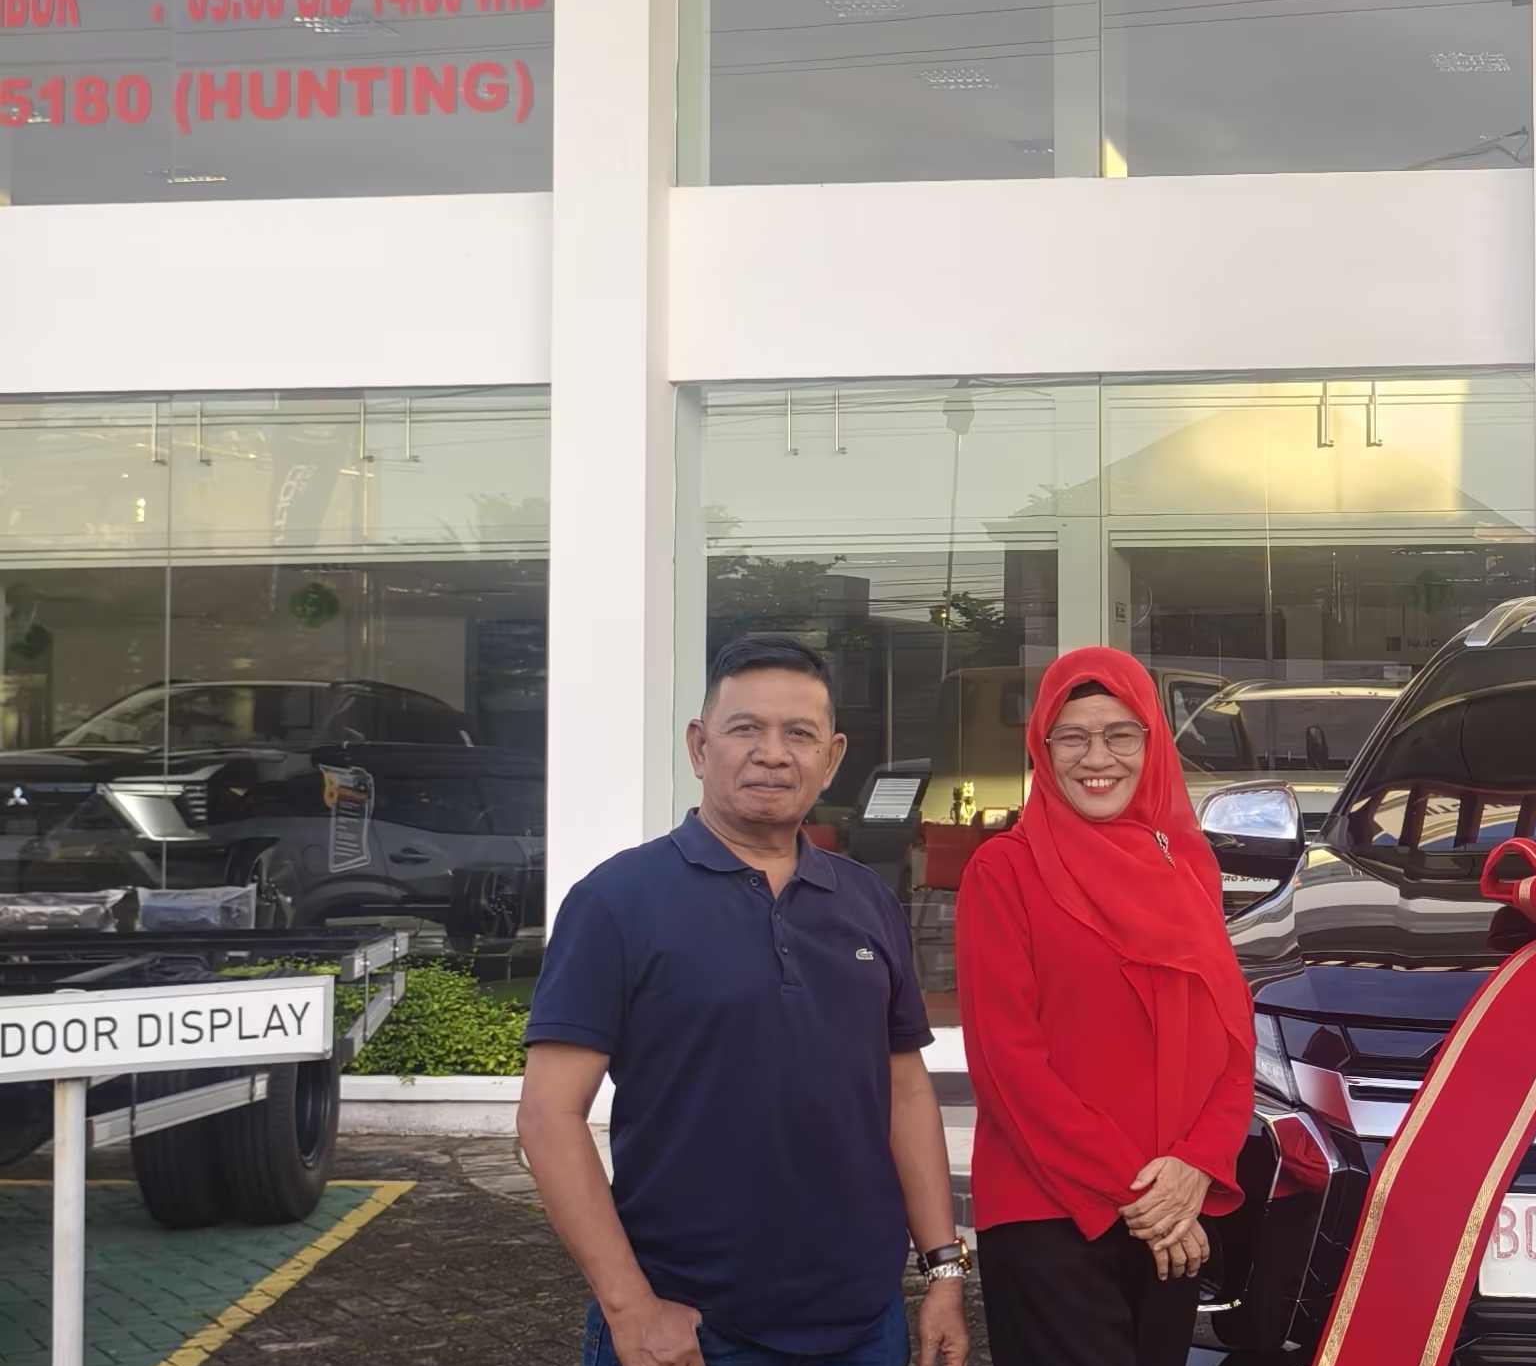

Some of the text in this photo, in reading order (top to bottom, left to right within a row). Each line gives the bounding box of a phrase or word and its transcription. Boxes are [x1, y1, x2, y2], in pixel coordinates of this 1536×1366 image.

[0, 61, 534, 136] 5180 (HUNTING)
[0, 1001, 311, 1059] DOOR DISPLAY
